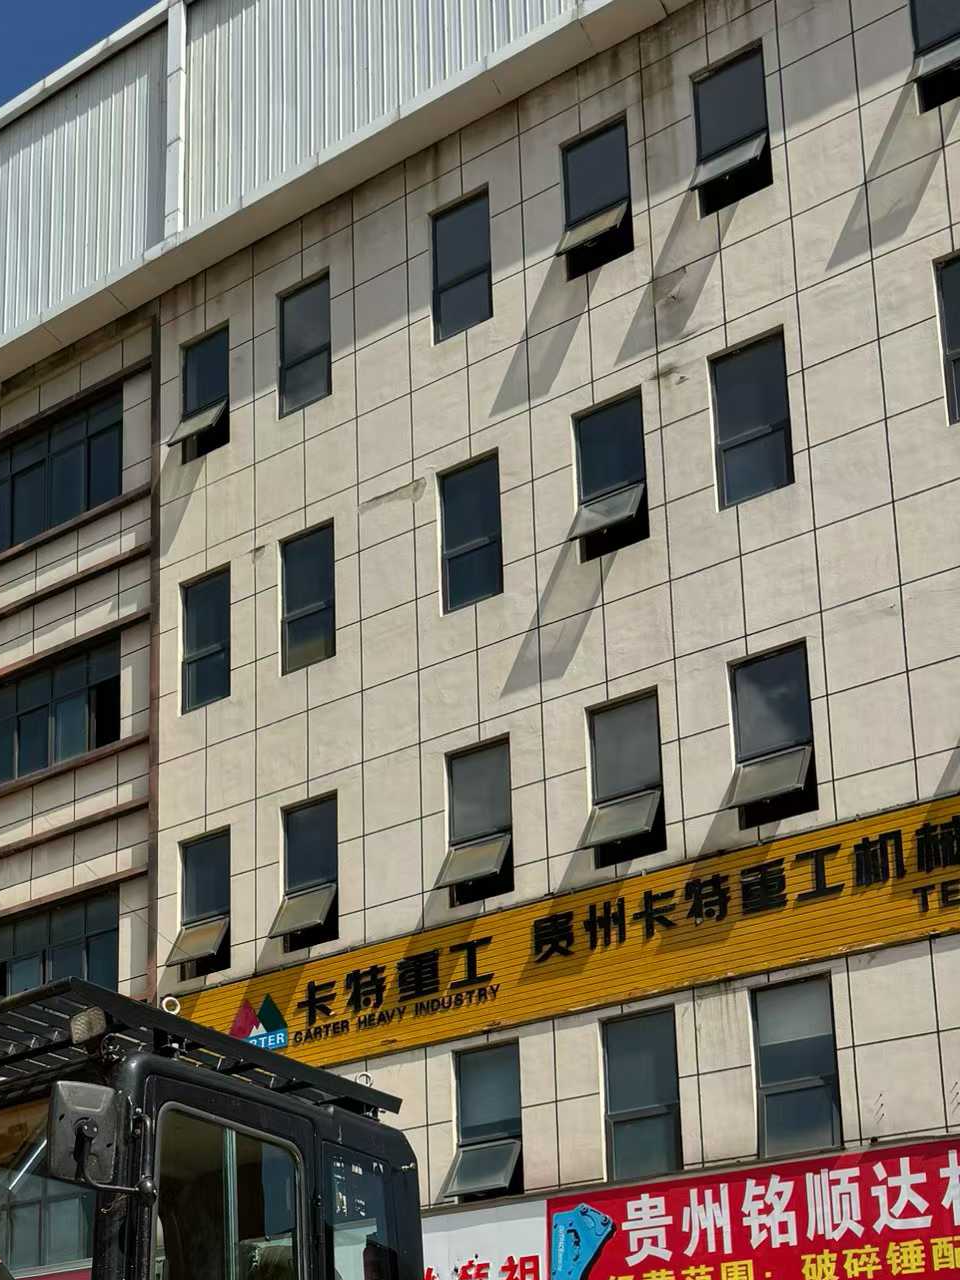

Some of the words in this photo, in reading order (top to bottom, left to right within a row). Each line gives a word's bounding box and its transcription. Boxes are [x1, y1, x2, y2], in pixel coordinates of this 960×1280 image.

[531, 815, 960, 963] 贵州卡特重工机械
[293, 1019, 350, 1045] CARTER
[358, 1006, 406, 1032] HEAVY
[415, 984, 501, 1017] INDUSTRY
[296, 936, 495, 1026] 卡特重工
